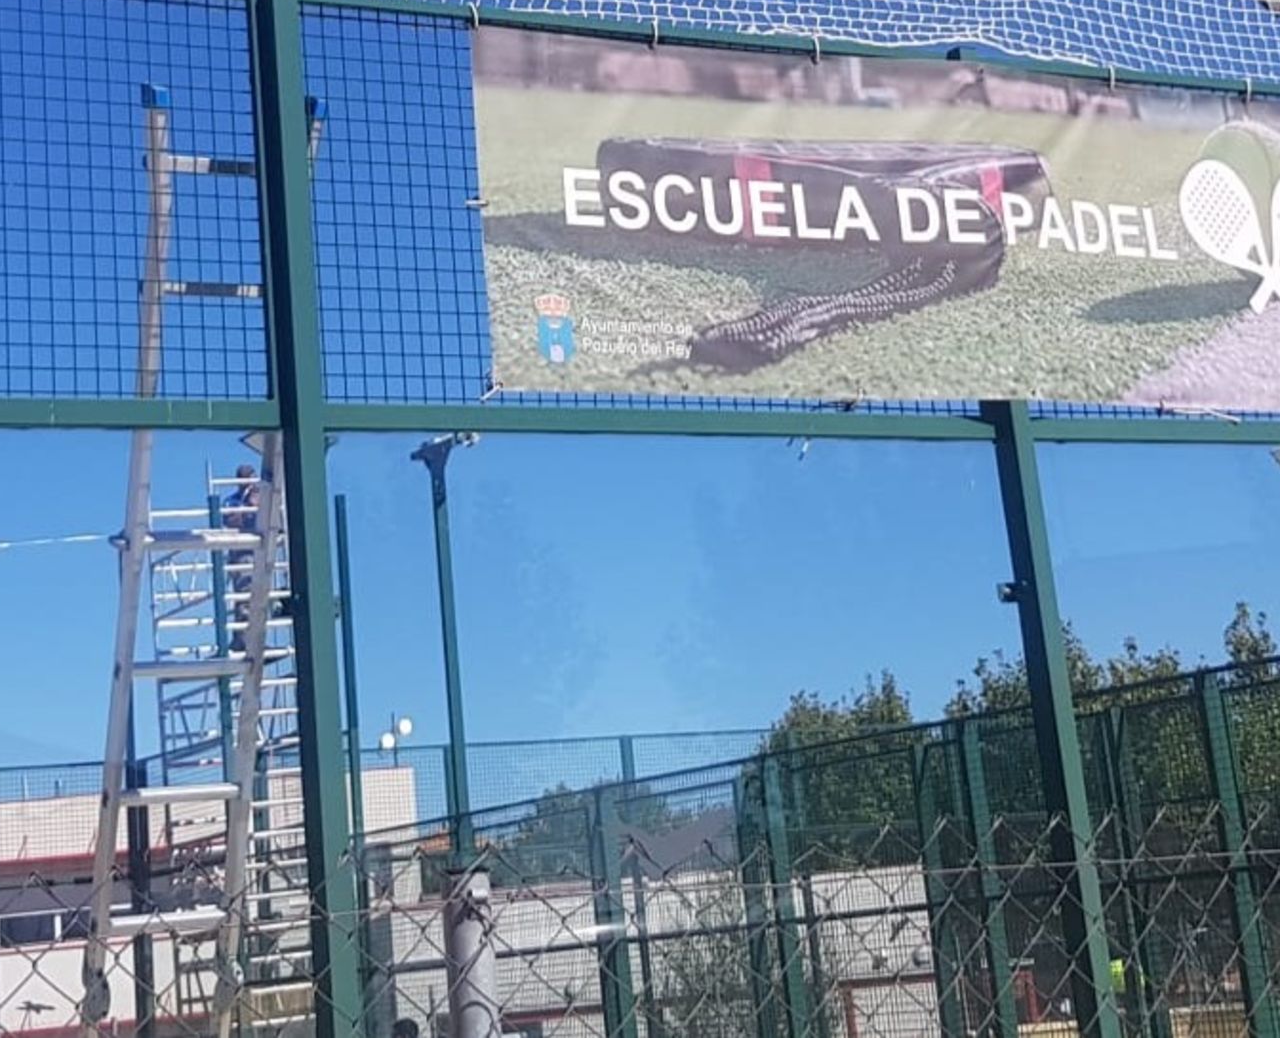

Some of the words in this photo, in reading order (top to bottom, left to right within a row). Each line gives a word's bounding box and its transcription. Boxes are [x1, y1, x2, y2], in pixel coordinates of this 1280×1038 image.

[562, 167, 879, 240] ESCUELA
[896, 188, 987, 243] DE
[1001, 192, 1179, 260] PADEL
[581, 316, 673, 336] Ayuntamiento
[583, 337, 638, 355] Pozuelo
[641, 339, 662, 355] del
[665, 341, 692, 359] Rey
